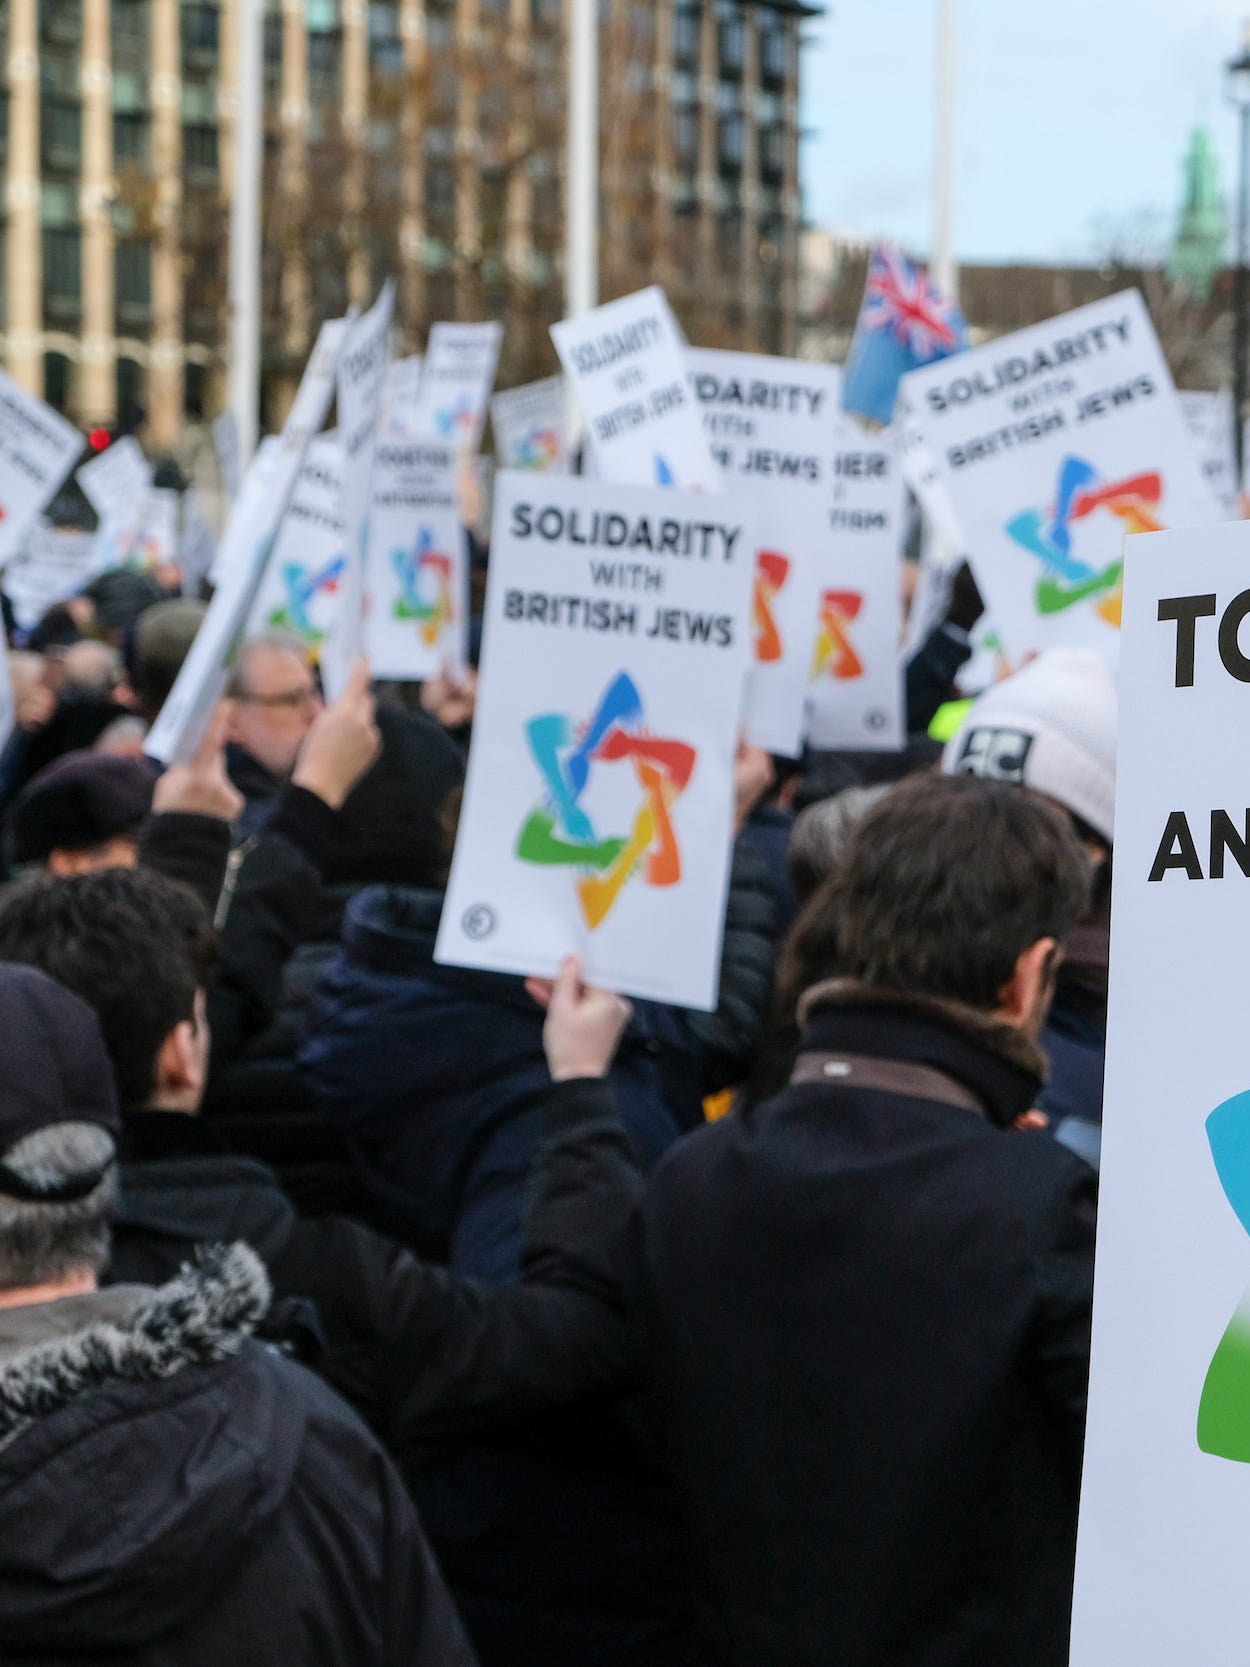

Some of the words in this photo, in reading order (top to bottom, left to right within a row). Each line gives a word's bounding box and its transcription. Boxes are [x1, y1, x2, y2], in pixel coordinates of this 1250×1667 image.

[571, 317, 662, 375] SOLIDARITY
[927, 316, 1131, 410] SOLIDARITY
[688, 373, 823, 415] DARITY
[948, 411, 1064, 468] BRITISH
[1076, 375, 1154, 424] JEWS
[1008, 378, 1075, 411] WITH
[741, 447, 820, 480] JEWS
[511, 502, 741, 559] SOLIDARITY
[590, 559, 664, 592] WITH
[504, 588, 637, 633] BRITISH
[647, 607, 733, 648] JEWS
